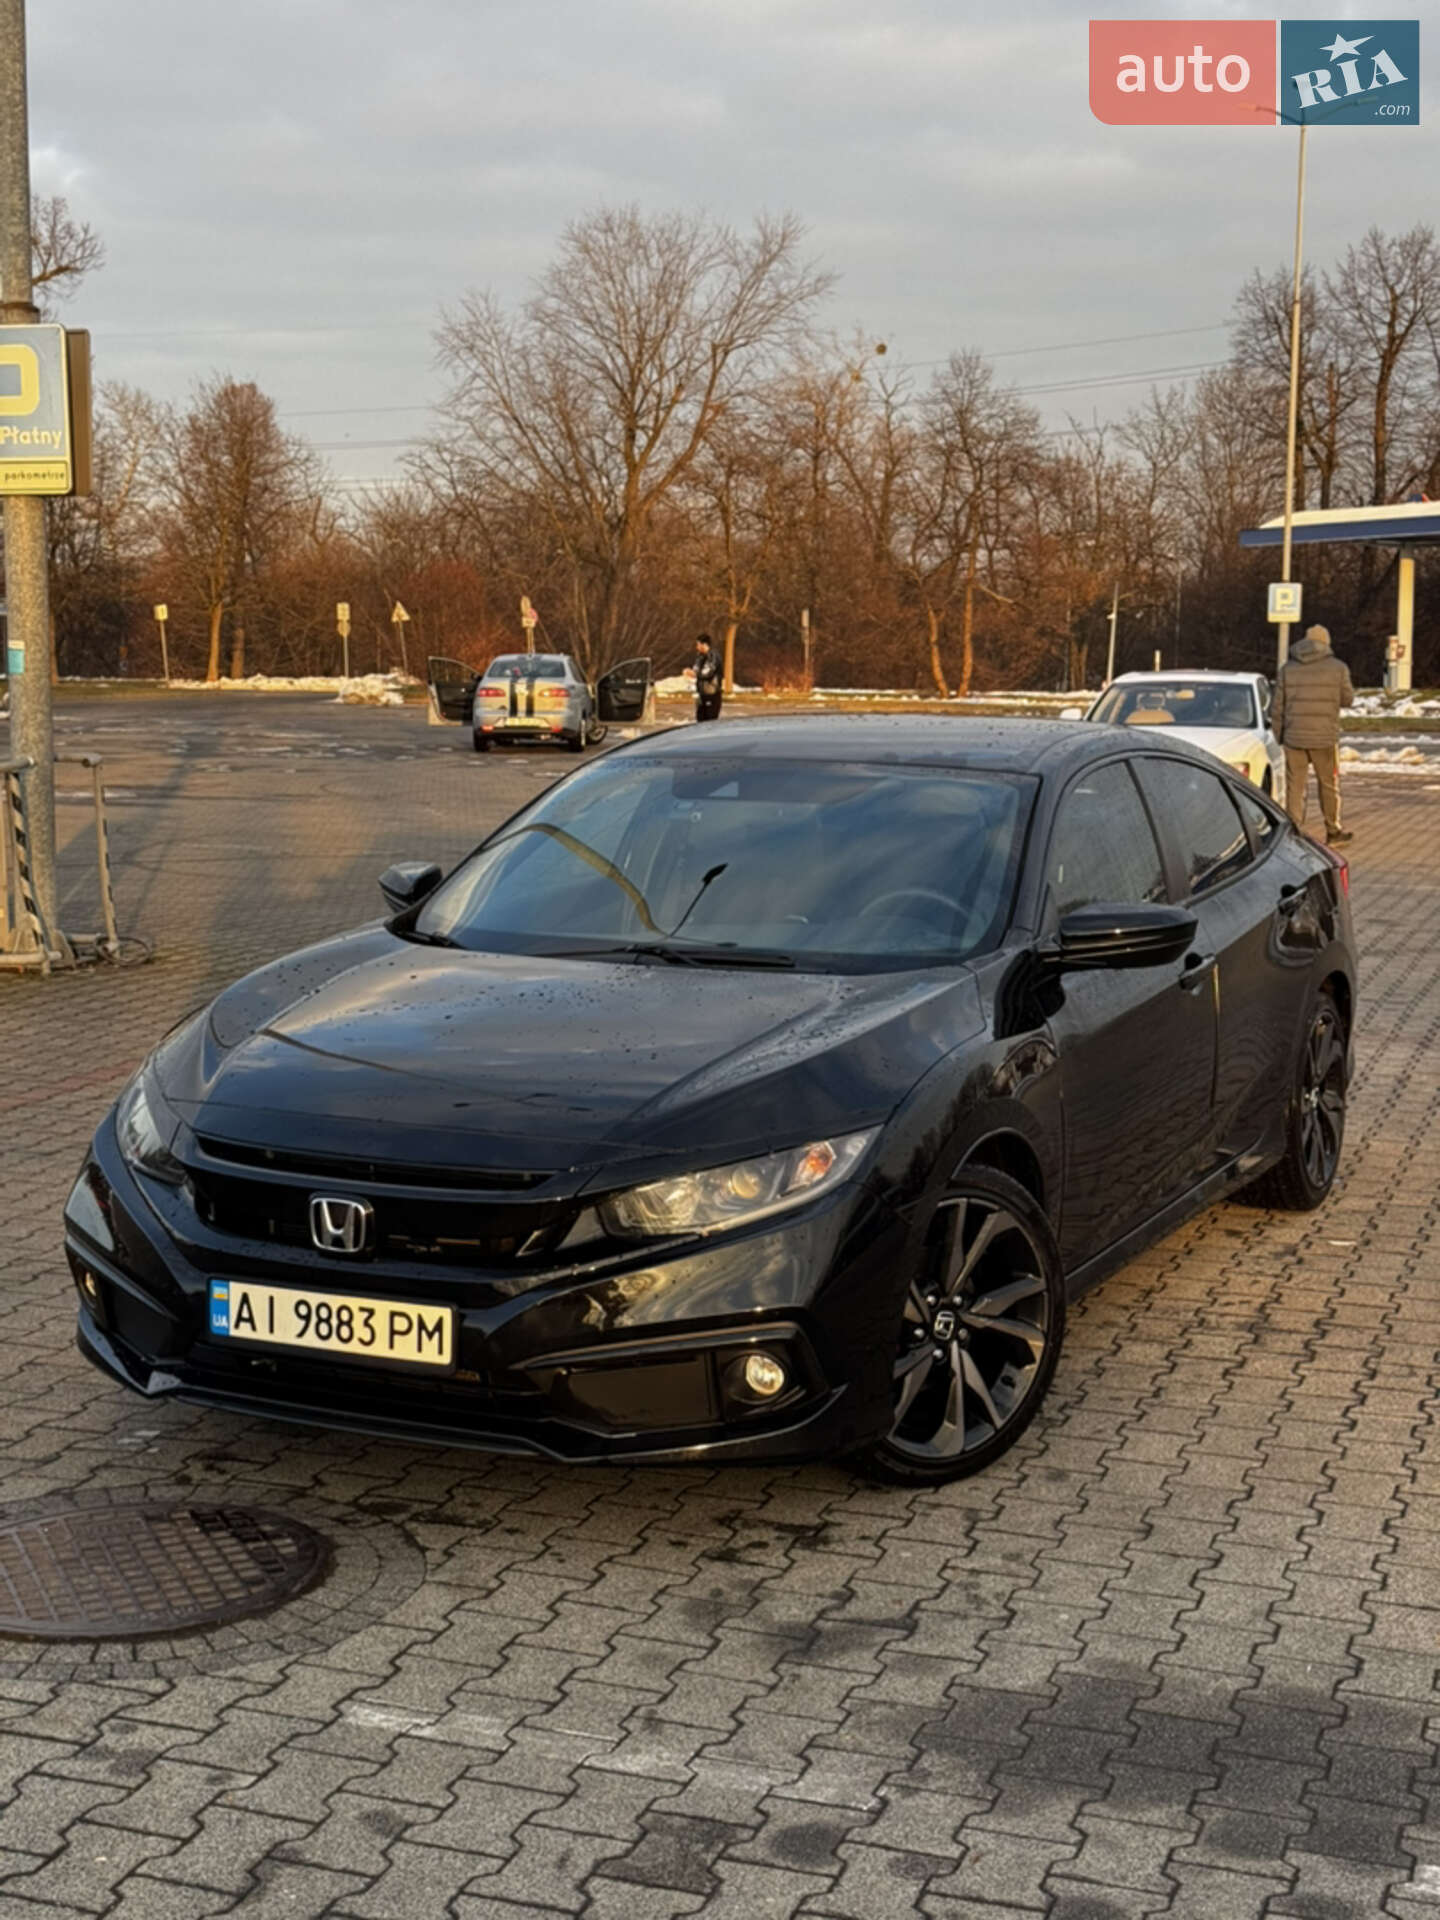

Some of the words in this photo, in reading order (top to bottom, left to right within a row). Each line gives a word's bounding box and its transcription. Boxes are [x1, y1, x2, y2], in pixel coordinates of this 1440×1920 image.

[0, 425, 62, 449] Płatny
[213, 1313, 229, 1329] UA
[233, 1292, 275, 1334] AI
[294, 1299, 376, 1347] 9883
[389, 1310, 444, 1356] PM
